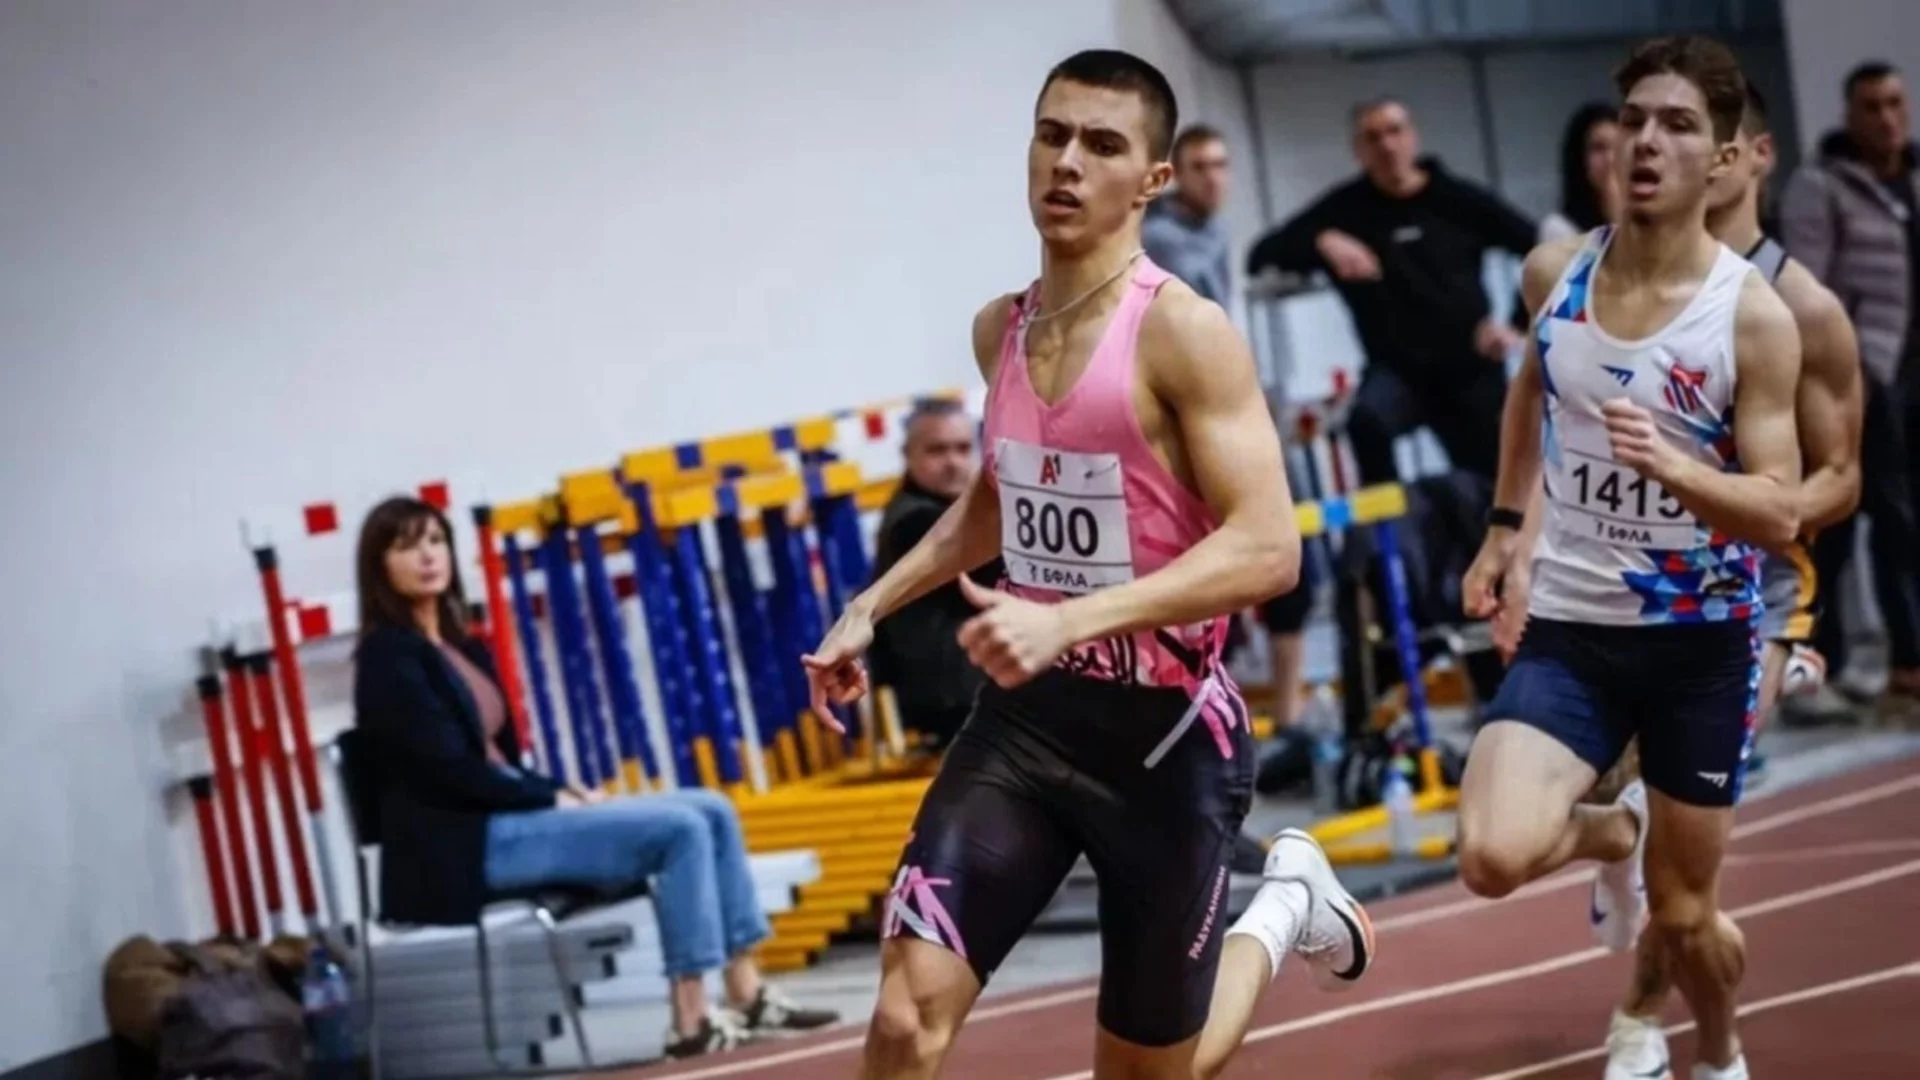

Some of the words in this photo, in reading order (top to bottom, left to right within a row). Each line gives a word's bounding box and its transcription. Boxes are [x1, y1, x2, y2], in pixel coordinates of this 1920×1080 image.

[1041, 453, 1061, 485] A1
[1572, 463, 1686, 519] 1415
[1015, 497, 1099, 558] 800
[1043, 567, 1088, 588] БФЛА
